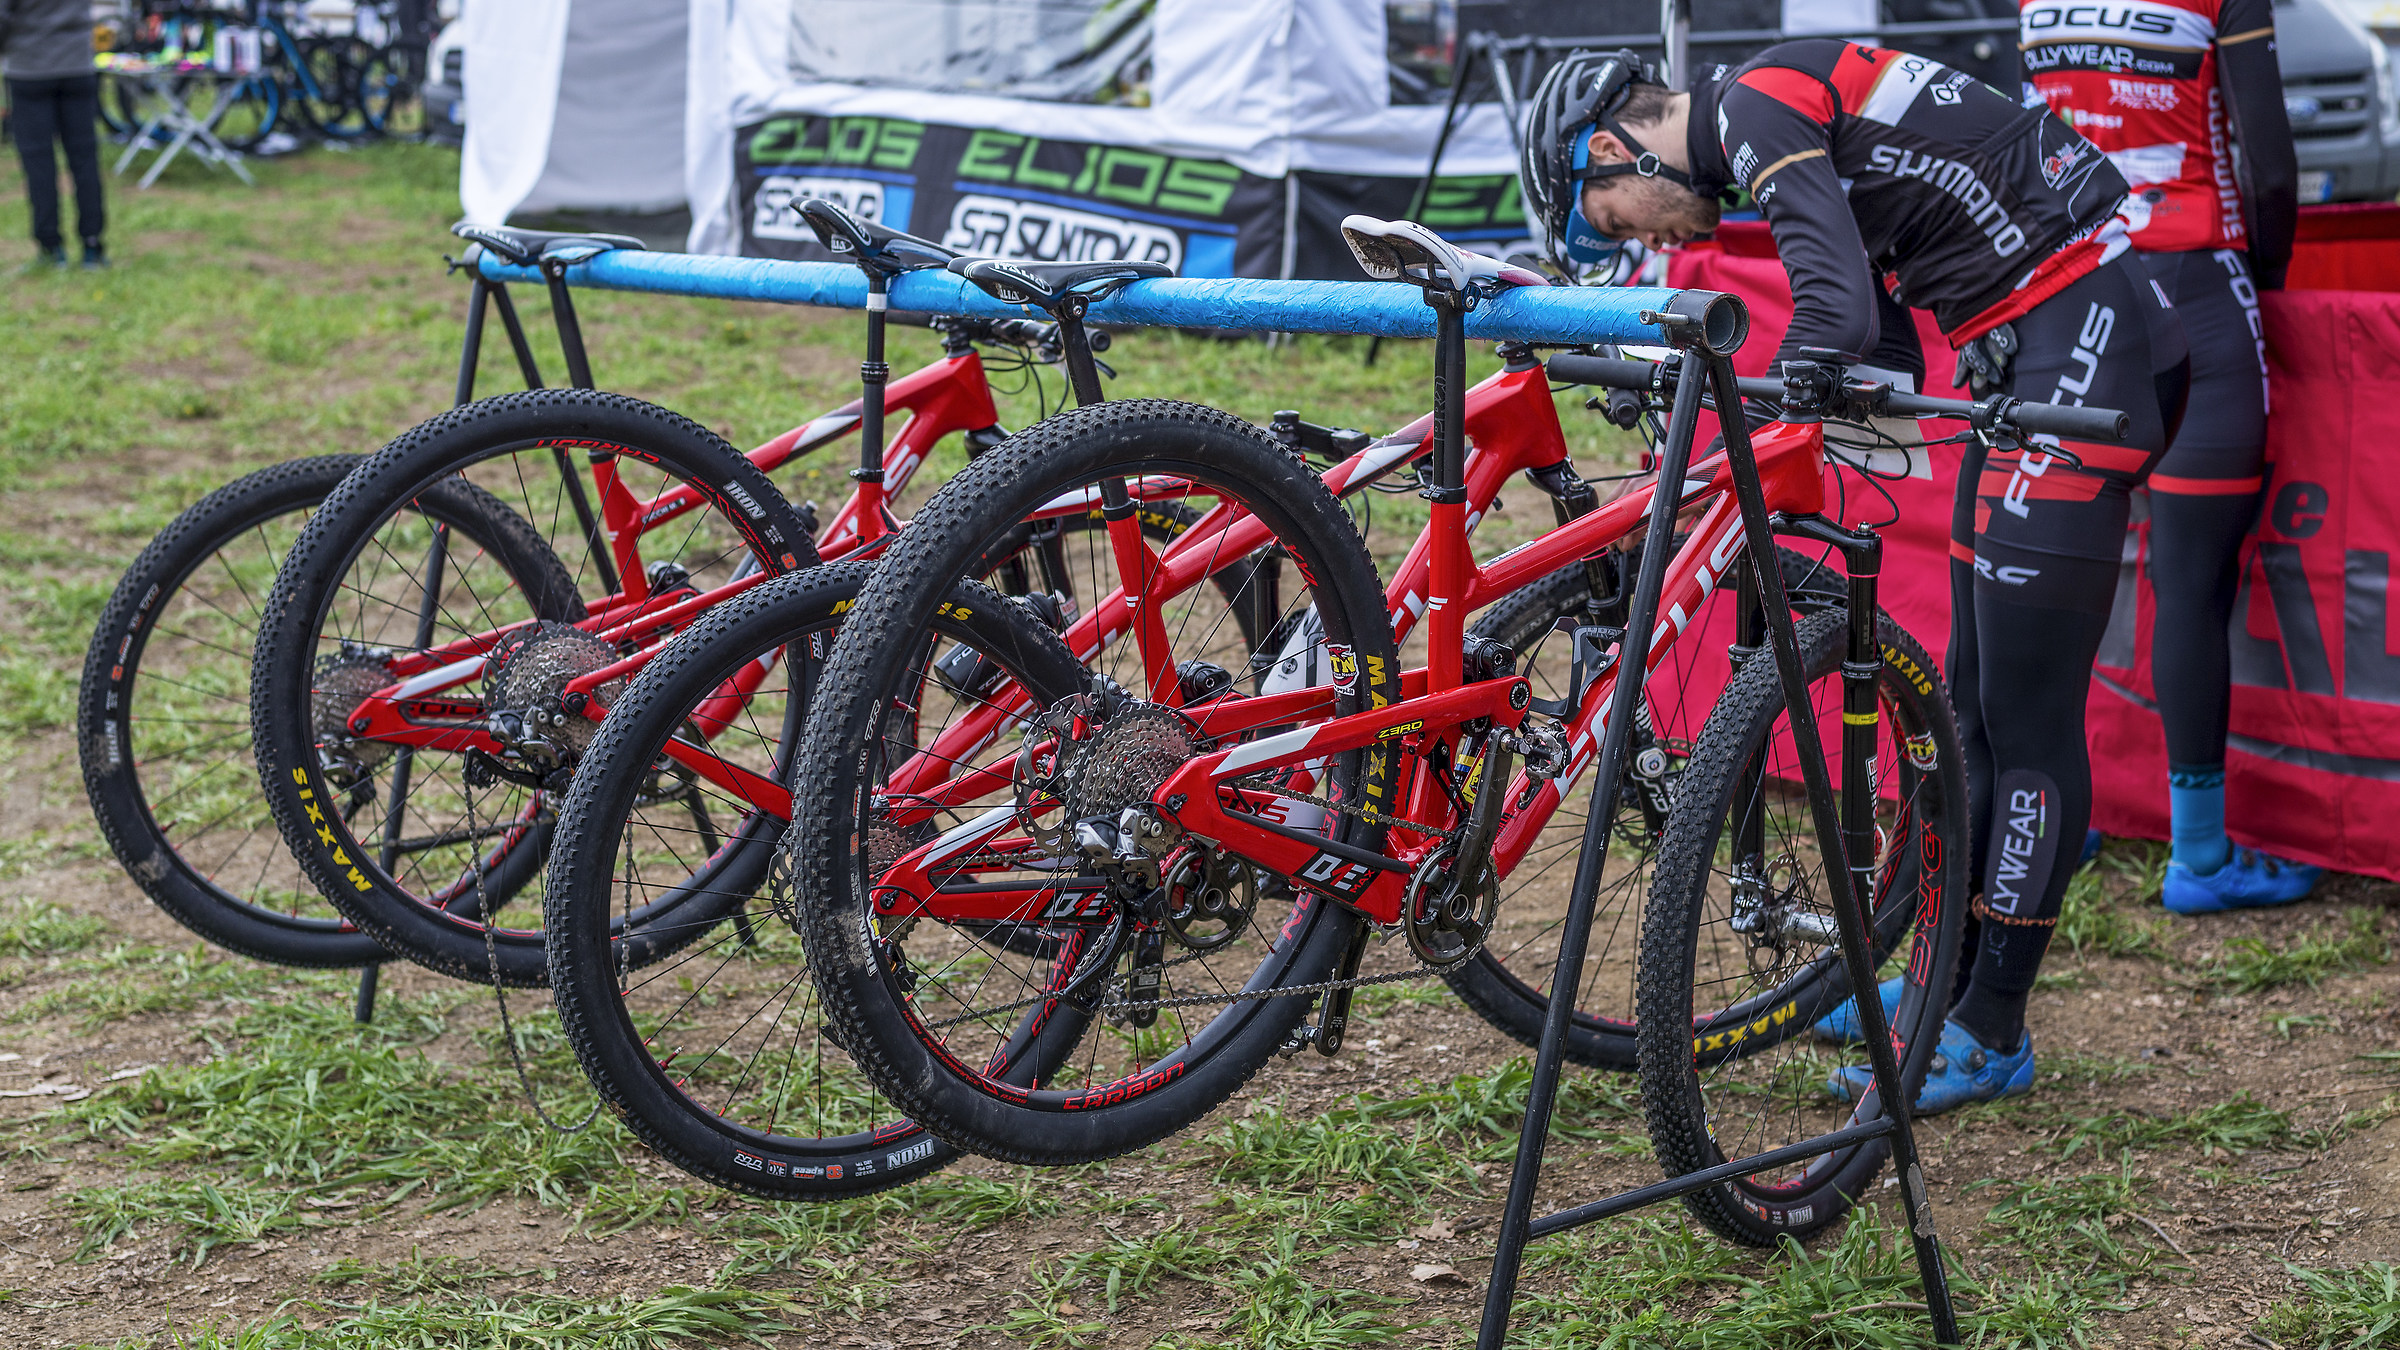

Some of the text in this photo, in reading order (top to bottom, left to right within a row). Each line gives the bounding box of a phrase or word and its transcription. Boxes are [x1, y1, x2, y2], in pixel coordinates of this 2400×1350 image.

[751, 117, 927, 170] ELIOS
[957, 130, 1242, 216] ELIOS
[1865, 143, 2027, 259] SHIMANO
[722, 479, 767, 521] IKON
[864, 698, 881, 741] TR
[1361, 655, 1389, 827] MAXIS
[292, 766, 374, 893] MAXXIS
[1990, 788, 2039, 916] LYWEAR
[1349, 868, 1375, 893] MAX
[922, 1036, 982, 1087] PERFORMANCE
[1062, 1061, 1186, 1111] CARBON
[733, 1152, 763, 1172] TR
[767, 1164, 786, 1177] EXO
[791, 1165, 825, 1177] speed
[826, 1164, 844, 1180] 3C
[886, 1138, 936, 1171] IKON
[1786, 1206, 1814, 1227] IKON
